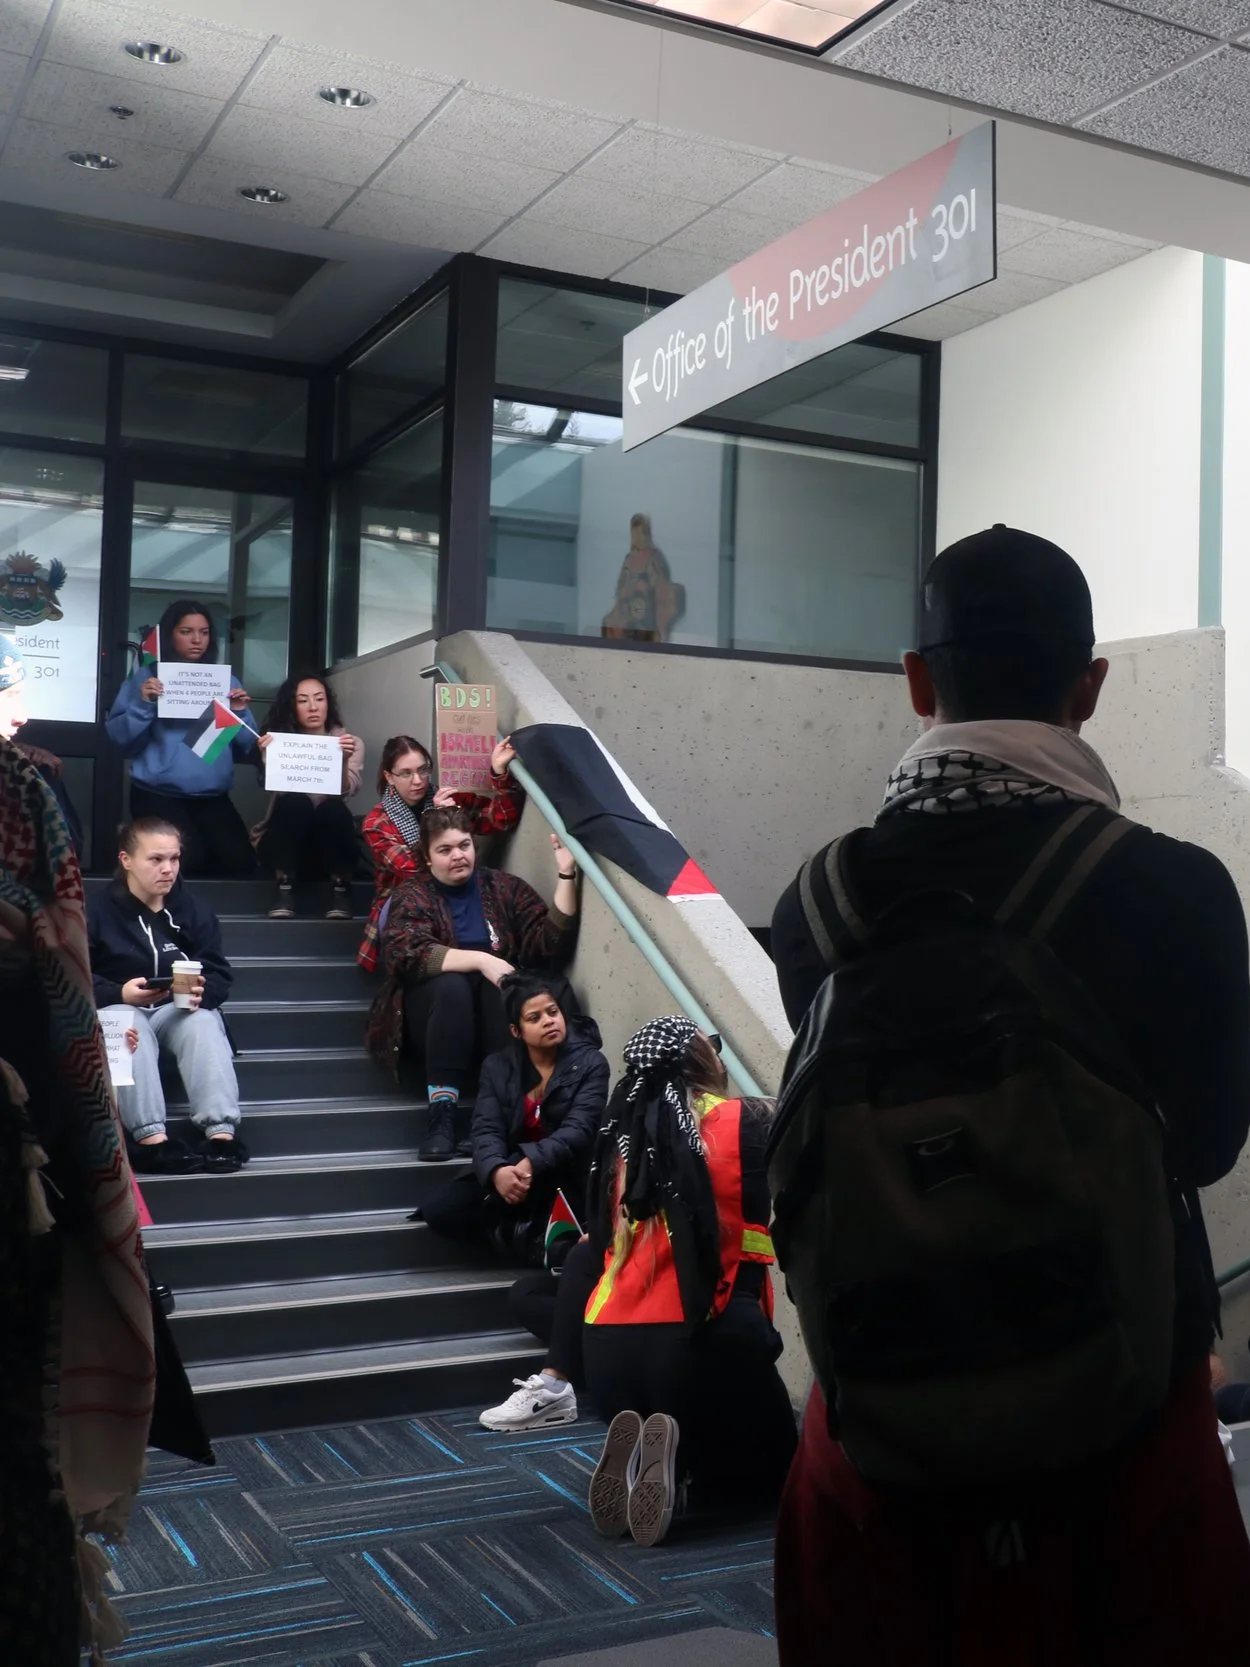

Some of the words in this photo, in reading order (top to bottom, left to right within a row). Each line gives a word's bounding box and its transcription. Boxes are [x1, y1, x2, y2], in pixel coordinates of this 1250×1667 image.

[652, 329, 707, 402] Office
[714, 298, 735, 370] of
[742, 286, 779, 343] the
[789, 207, 918, 321] President
[931, 188, 976, 263] 301
[16, 634, 61, 650] sident
[34, 665, 60, 679] 301
[440, 686, 491, 708] BDS!
[283, 741, 313, 749] EXPLAIN
[278, 752, 316, 761] UNLAWFUL
[317, 754, 333, 762] BAG
[280, 763, 309, 771] SEARCH
[310, 765, 330, 773] FROM
[286, 775, 312, 783] MARCH
